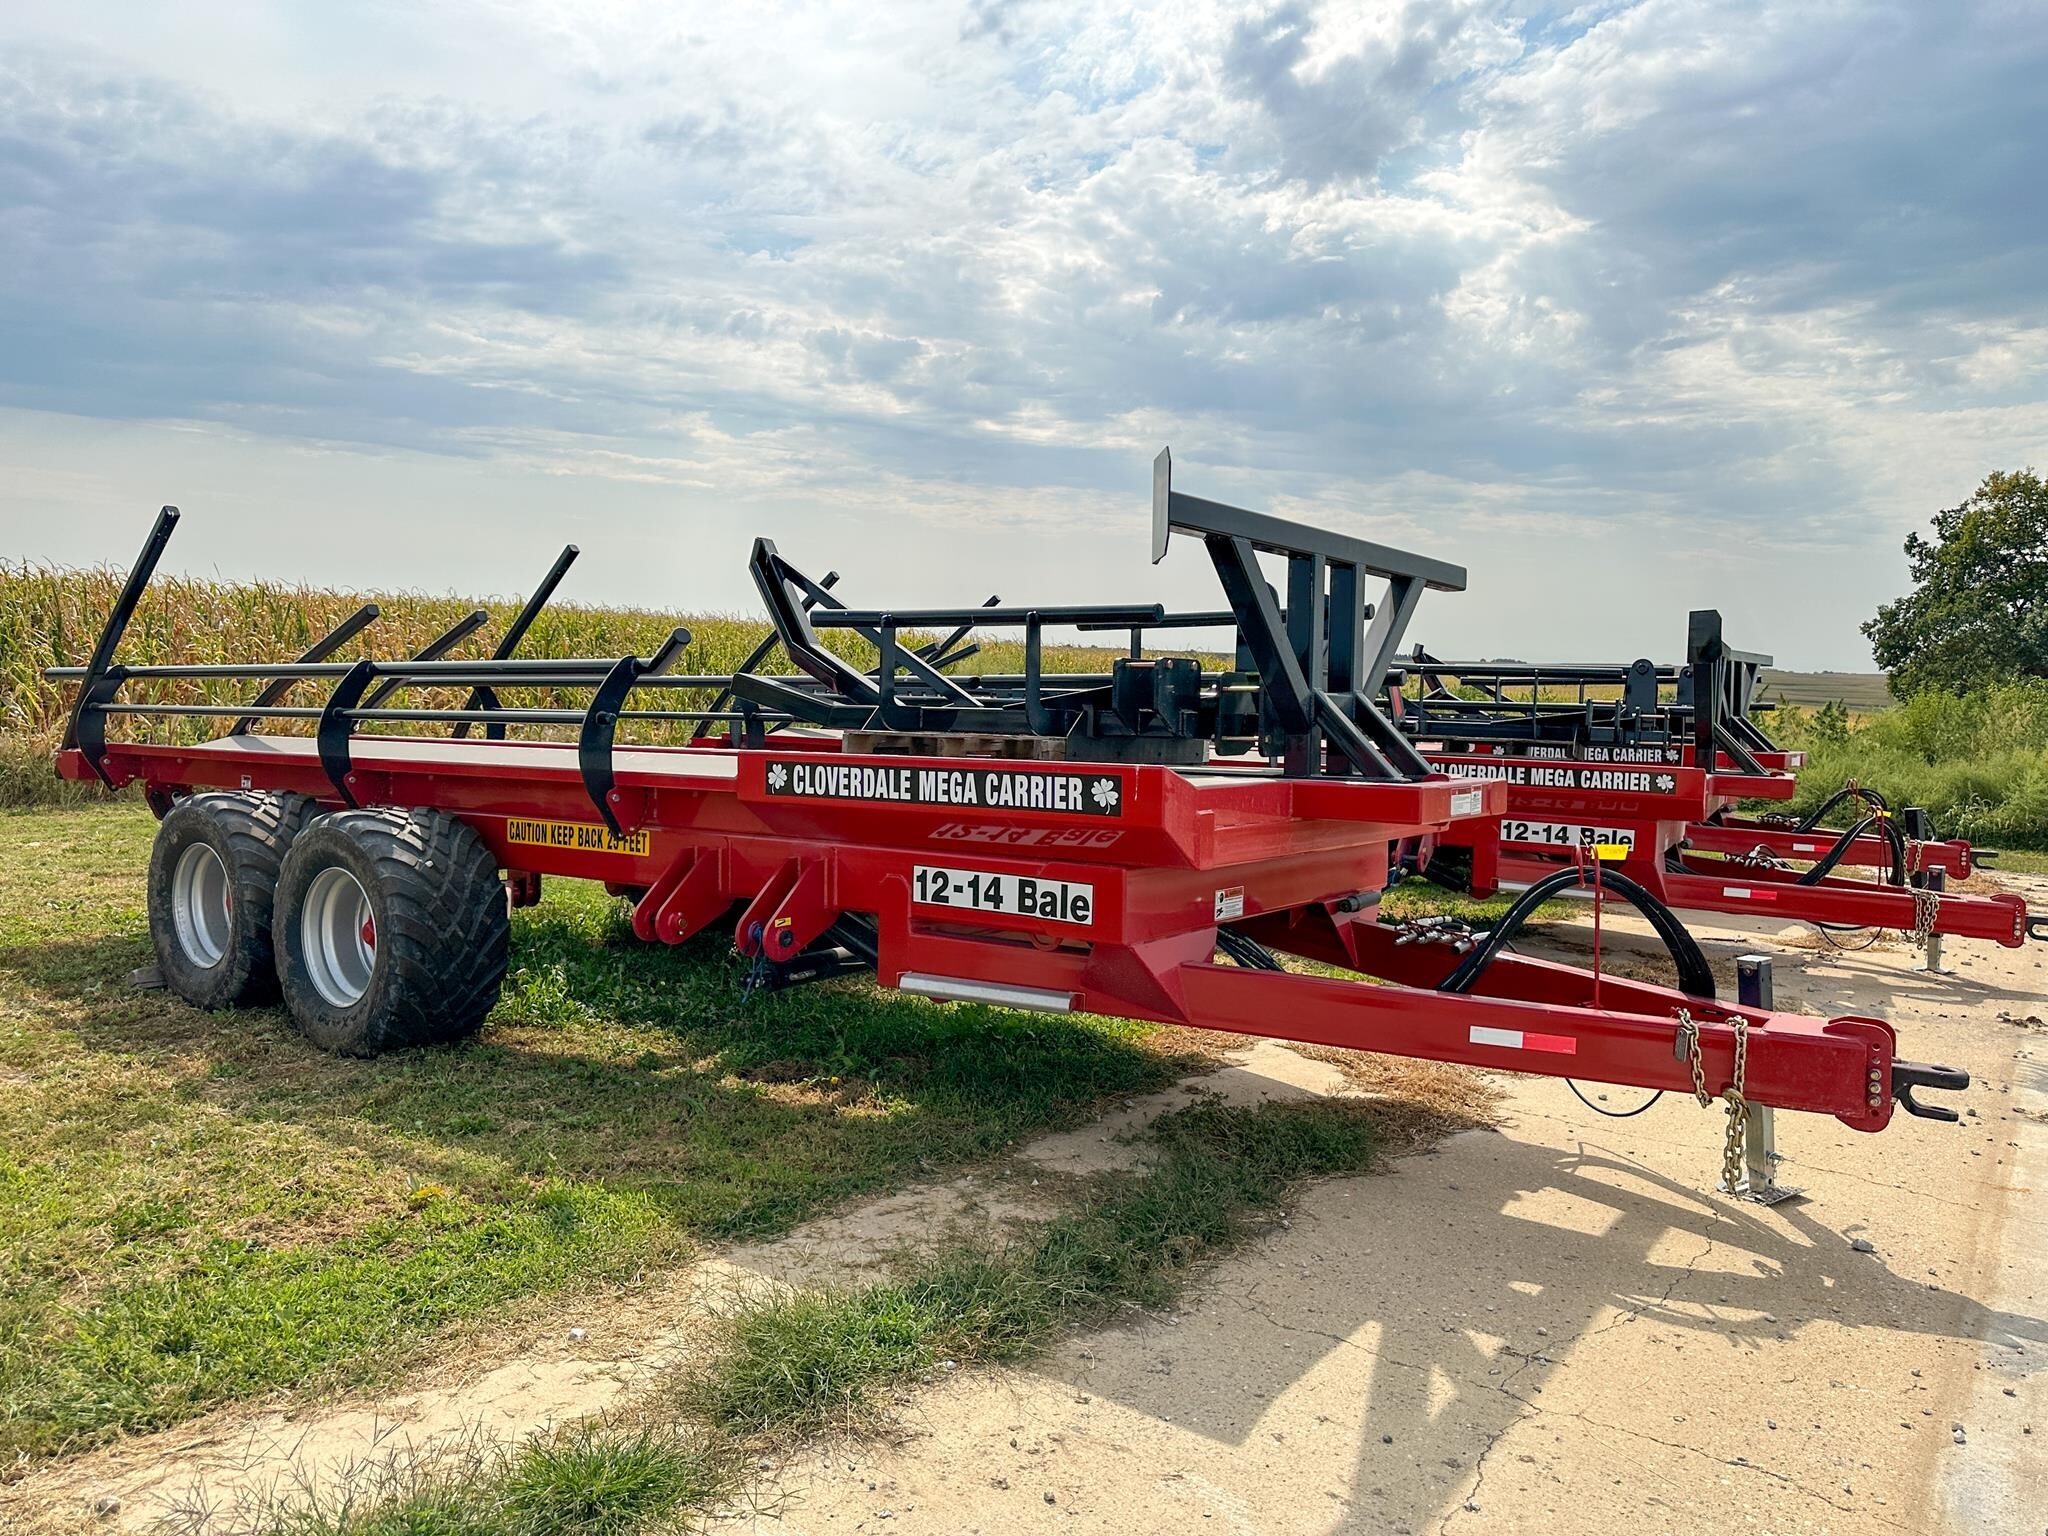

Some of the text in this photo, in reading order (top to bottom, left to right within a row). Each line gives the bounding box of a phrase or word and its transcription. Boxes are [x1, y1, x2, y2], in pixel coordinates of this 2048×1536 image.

[1584, 747, 1609, 761] EGA
[1613, 748, 1662, 763] CARRIER
[793, 764, 1083, 811] CLOVERDALE MEGA CARRIER
[1531, 768, 1575, 787] MEGA
[1580, 770, 1650, 791] CARRIER
[509, 821, 547, 843] CAUTION
[551, 824, 574, 846] KEEP
[578, 827, 603, 849] BACK
[1503, 821, 1569, 844] 12-14
[916, 869, 1090, 922] 12-14 Bale
